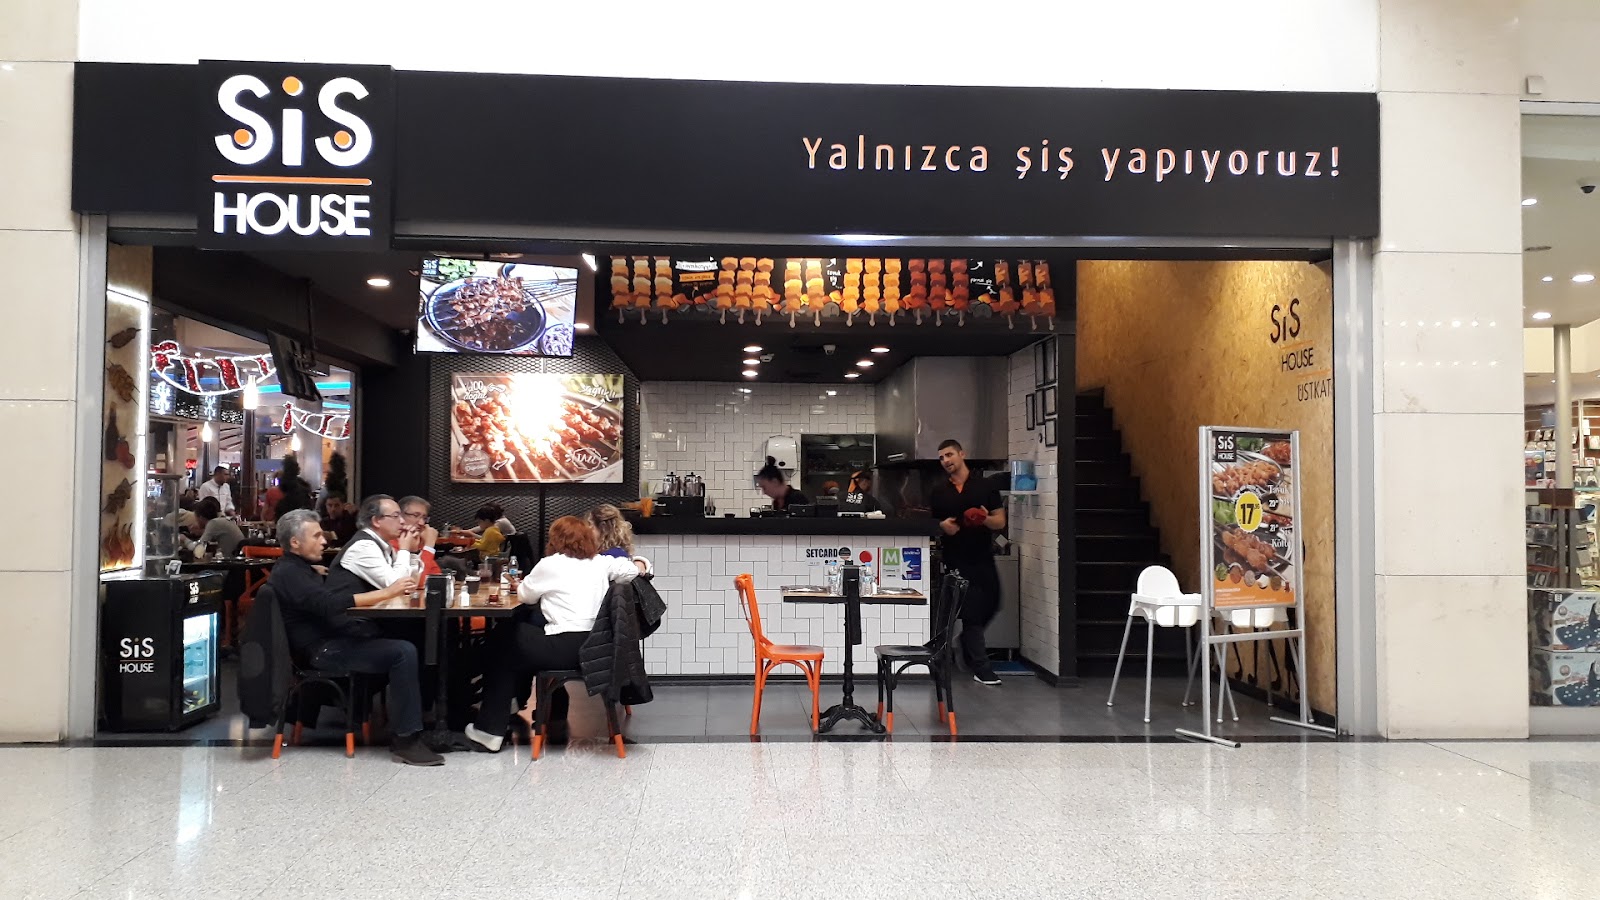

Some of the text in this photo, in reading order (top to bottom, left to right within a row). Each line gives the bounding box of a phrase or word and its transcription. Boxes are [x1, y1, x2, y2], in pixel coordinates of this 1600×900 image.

[214, 74, 373, 167] SiS
[802, 134, 1340, 182] Yalnızca şiş yapıyoruz!
[214, 192, 371, 236] HOUSE
[1281, 347, 1314, 372] HOUSE
[806, 548, 838, 558] SETCARD
[120, 637, 154, 658] SiS
[119, 663, 154, 673] HOUSE
